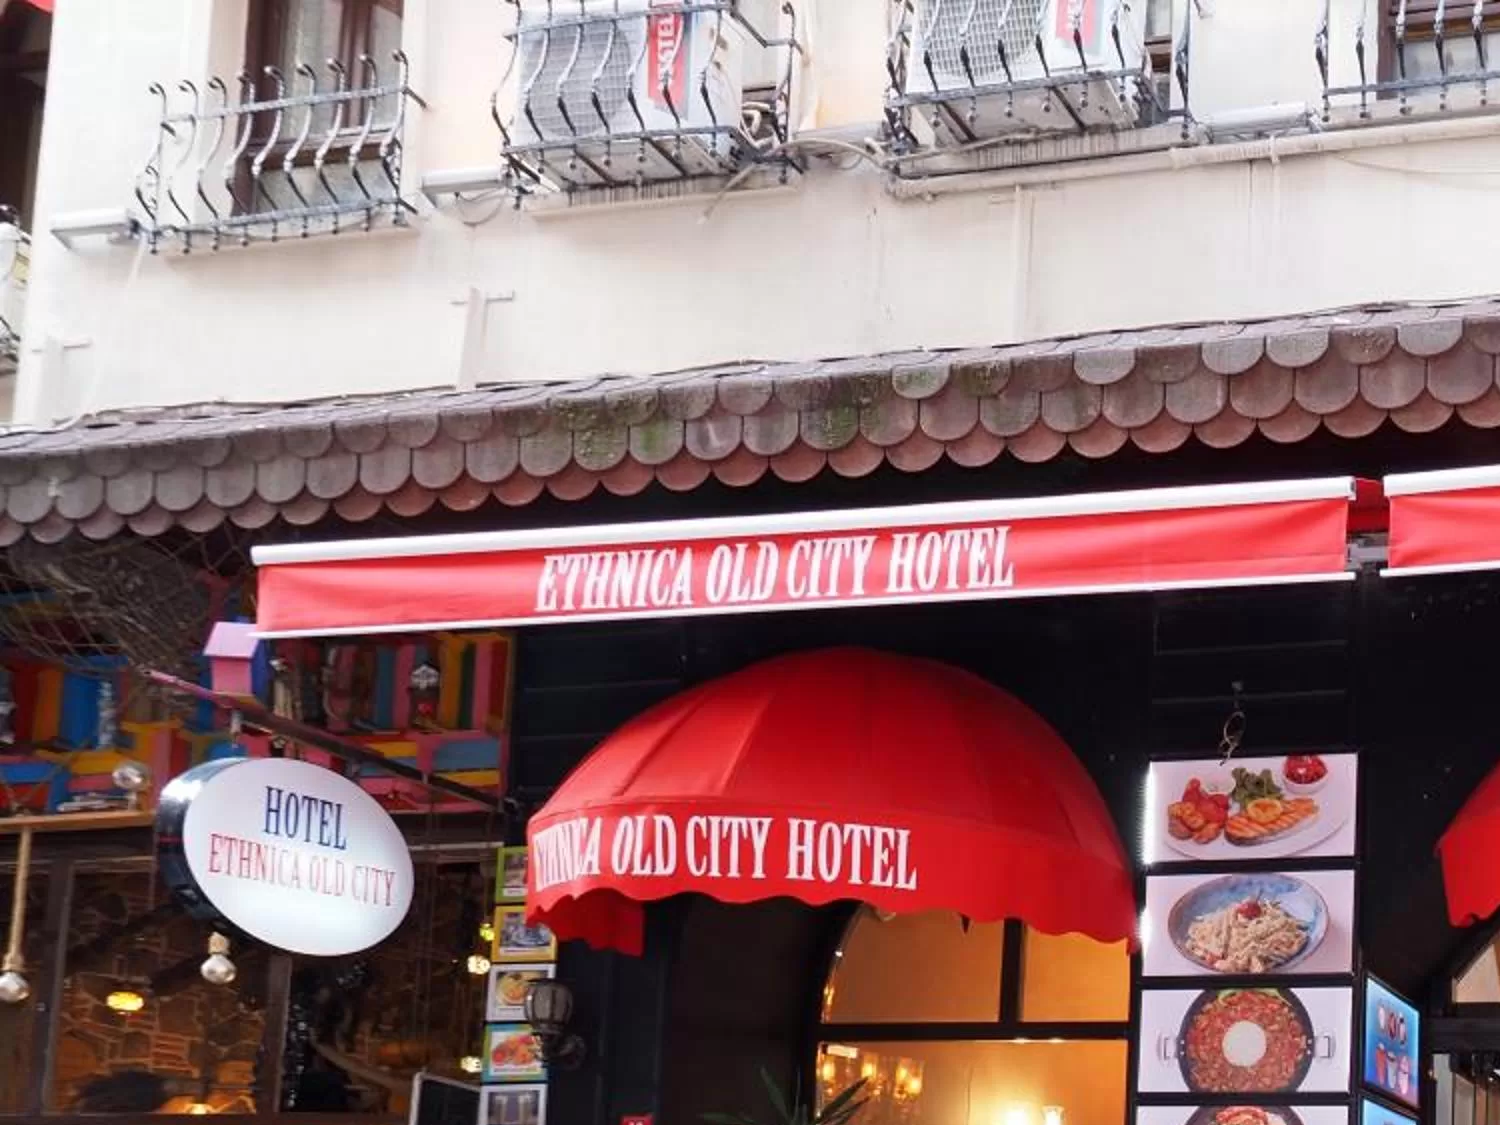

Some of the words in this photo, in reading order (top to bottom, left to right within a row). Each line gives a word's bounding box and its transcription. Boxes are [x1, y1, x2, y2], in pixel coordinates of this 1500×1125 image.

[534, 547, 693, 612] ETHNICA
[706, 541, 779, 604] OLD
[787, 535, 877, 598] CITY
[886, 525, 1014, 593] HOTEL
[263, 786, 347, 850] HOTEL
[611, 813, 678, 876] OLD
[686, 814, 772, 879] CITY
[785, 817, 917, 890] HOTEL
[208, 833, 301, 890] ETHNICA
[308, 855, 346, 897] OLD
[351, 865, 396, 907] CITY
